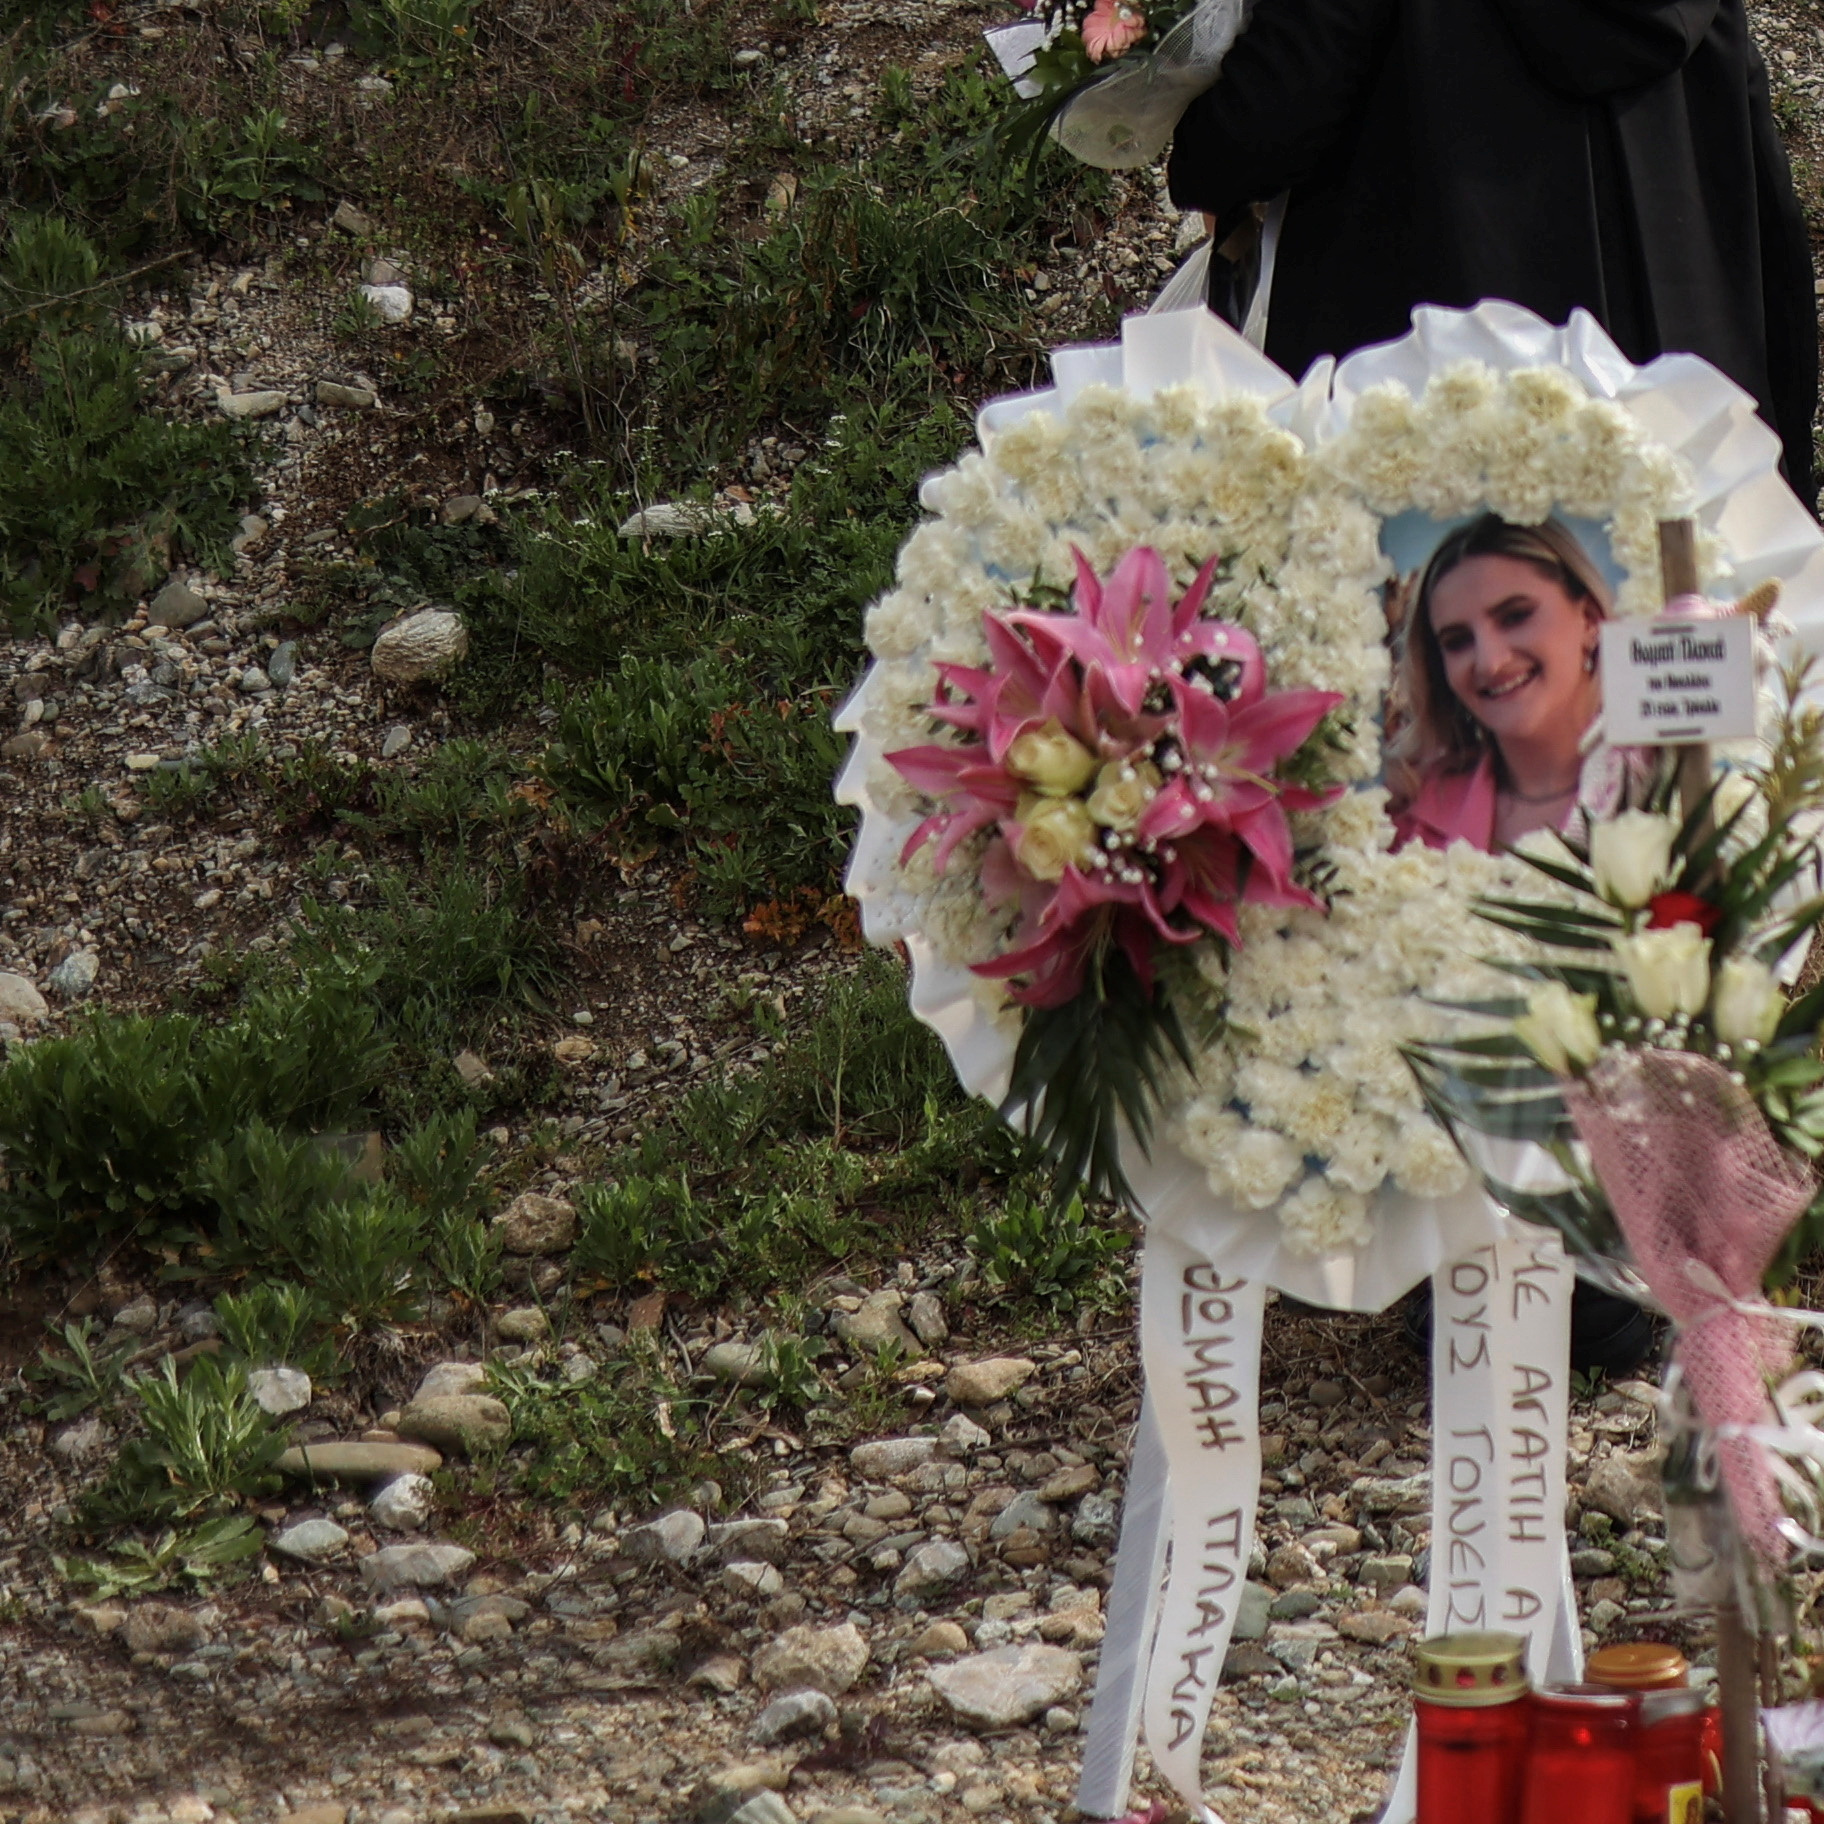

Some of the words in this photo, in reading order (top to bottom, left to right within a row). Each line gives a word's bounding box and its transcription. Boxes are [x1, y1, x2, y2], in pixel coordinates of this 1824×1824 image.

[1445, 1424, 1497, 1638] ΓΟΝΕΙΣ
[1508, 1363, 1553, 1544] ΑΓΑΠΗ
[1167, 1506, 1245, 1753] ΠΛΑΚΙΑ
